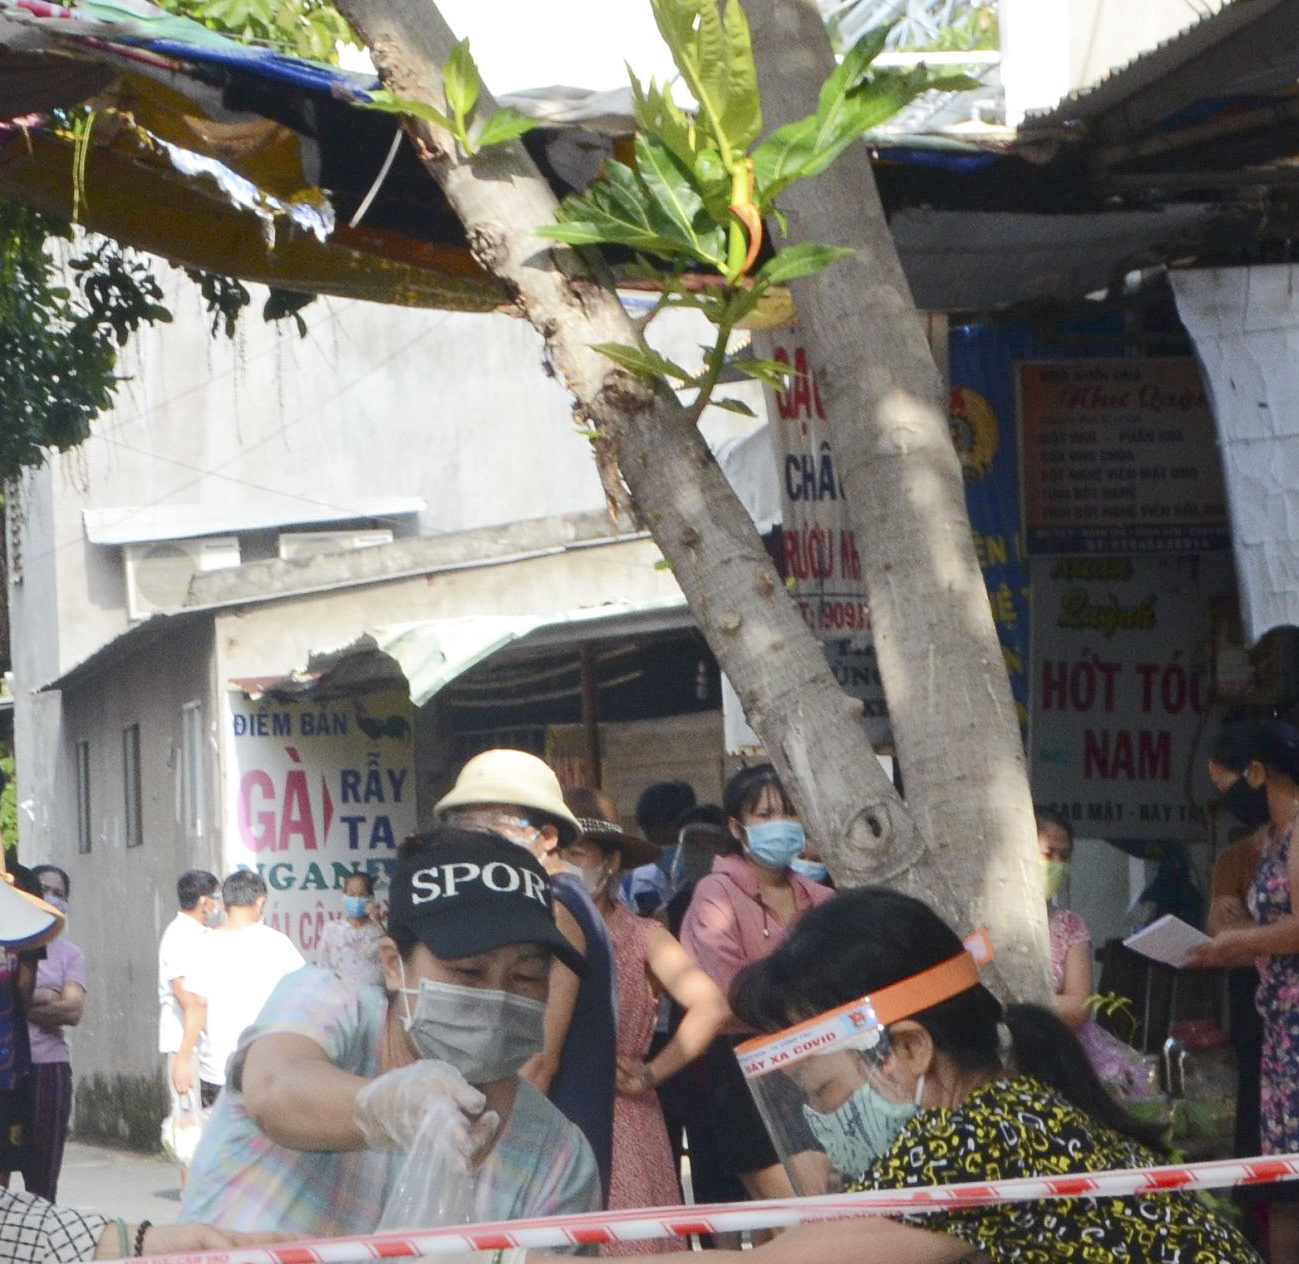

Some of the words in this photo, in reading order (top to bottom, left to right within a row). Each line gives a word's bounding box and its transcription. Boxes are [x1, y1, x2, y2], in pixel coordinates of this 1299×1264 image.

[785, 441, 846, 500] CHÂ
[1042, 648, 1122, 712] HỚT
[234, 704, 292, 737] ĐIỂM
[1084, 729, 1171, 780] NAM
[238, 747, 318, 852] GÀ
[340, 815, 396, 850] TA
[411, 861, 551, 906] SPOR
[793, 1031, 837, 1055] COVID
